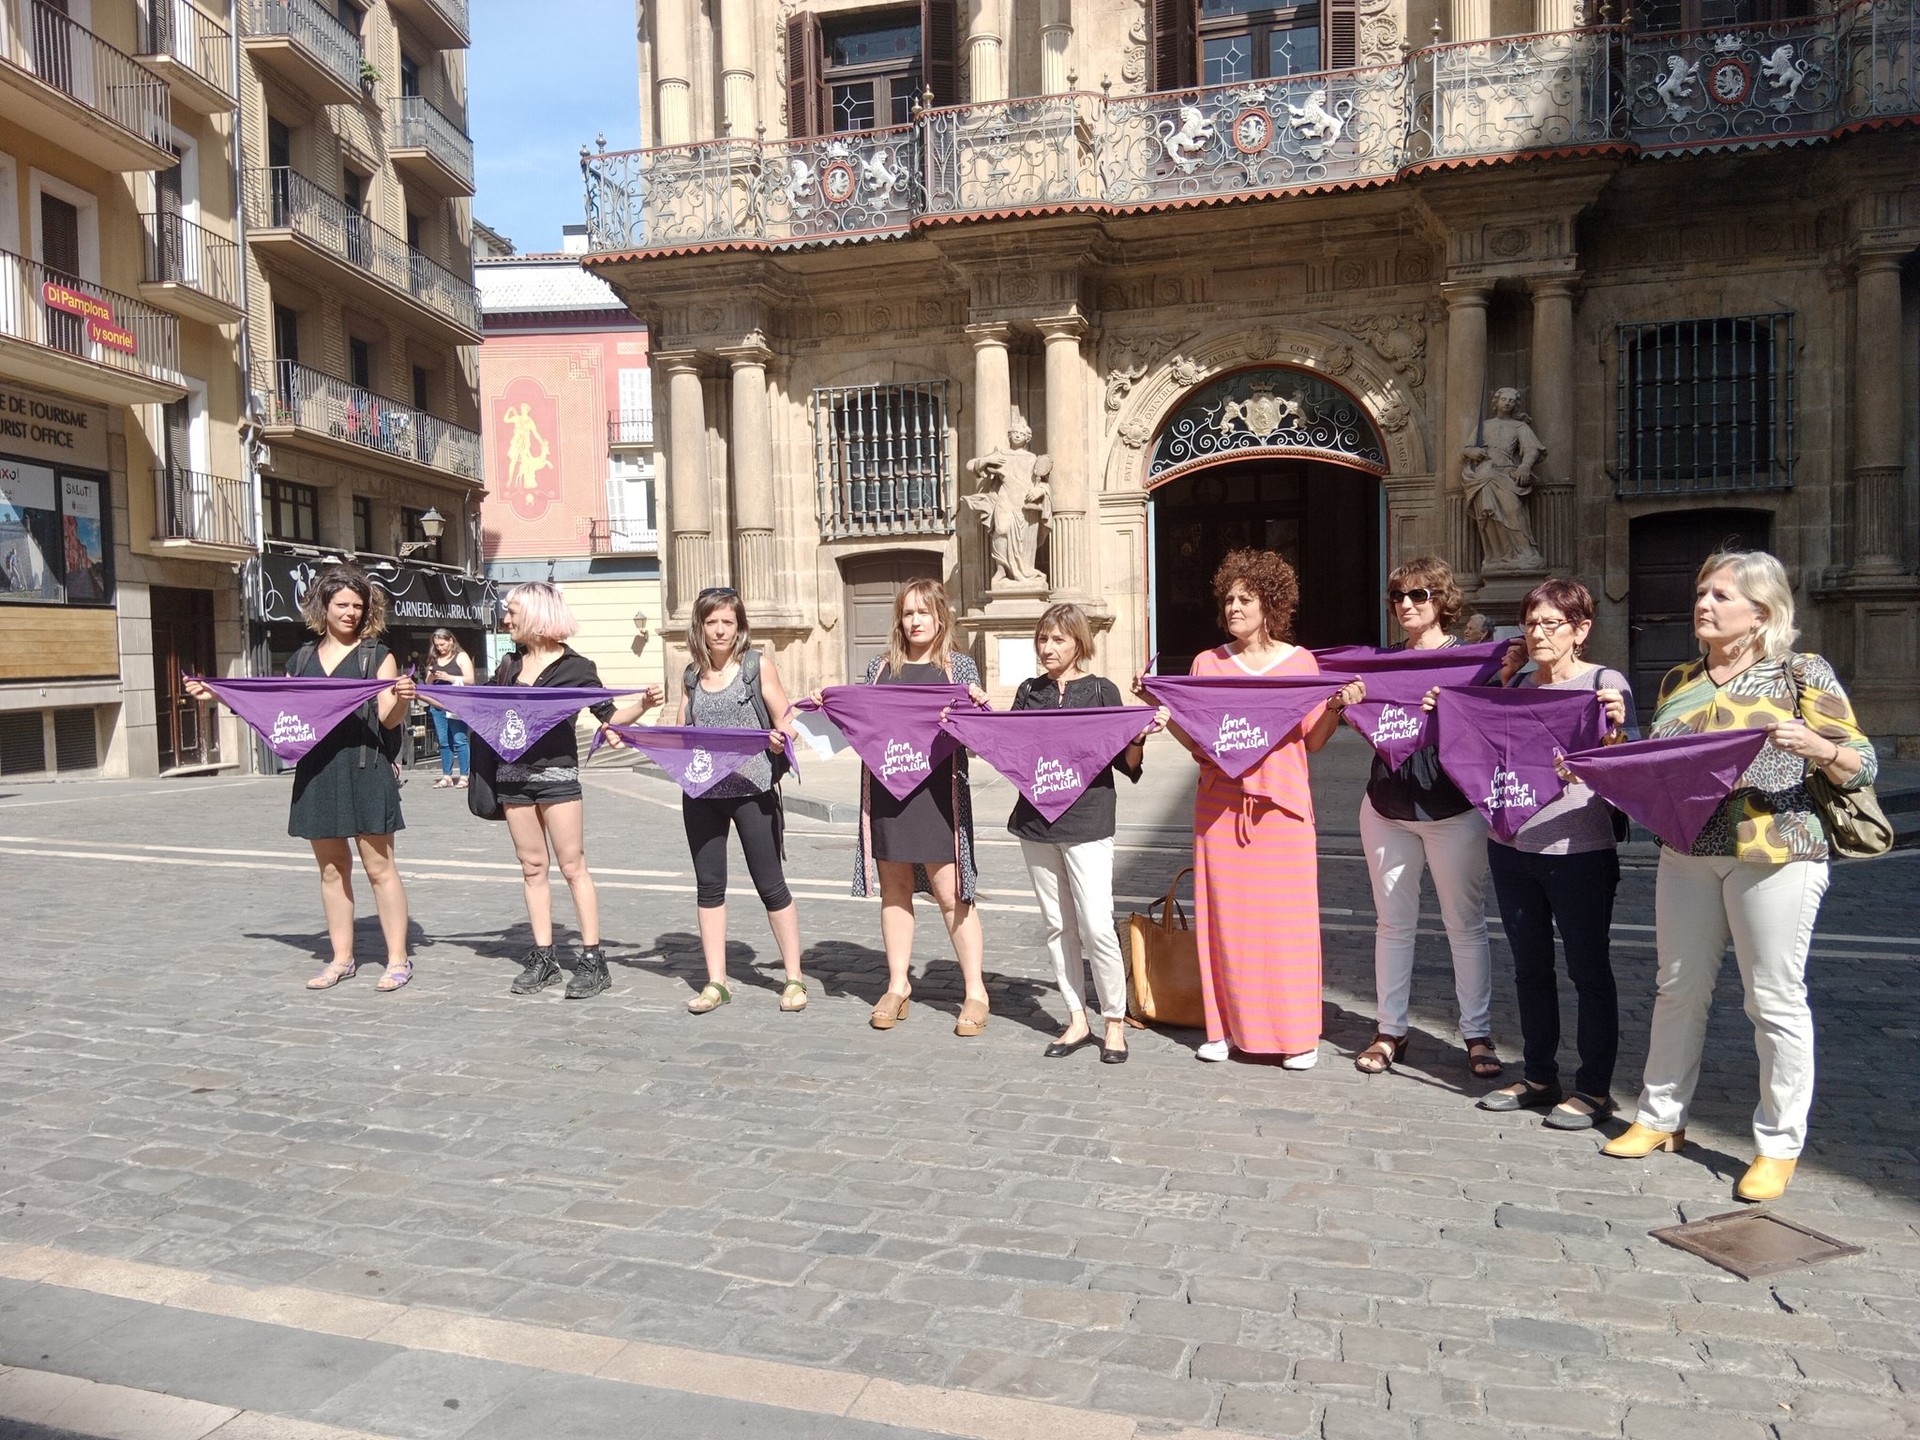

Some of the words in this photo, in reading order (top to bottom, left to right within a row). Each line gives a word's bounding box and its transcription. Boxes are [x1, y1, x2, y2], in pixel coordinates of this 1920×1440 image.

[48, 286, 60, 303] Di
[61, 290, 110, 320] Pamplona
[9, 396, 27, 416] DE
[29, 400, 88, 429] TOURISME
[1123, 453, 1135, 482] PATET
[1290, 344, 1311, 355] COR
[1395, 433, 1408, 469] MAGIS
[30, 425, 74, 449] OFFICE
